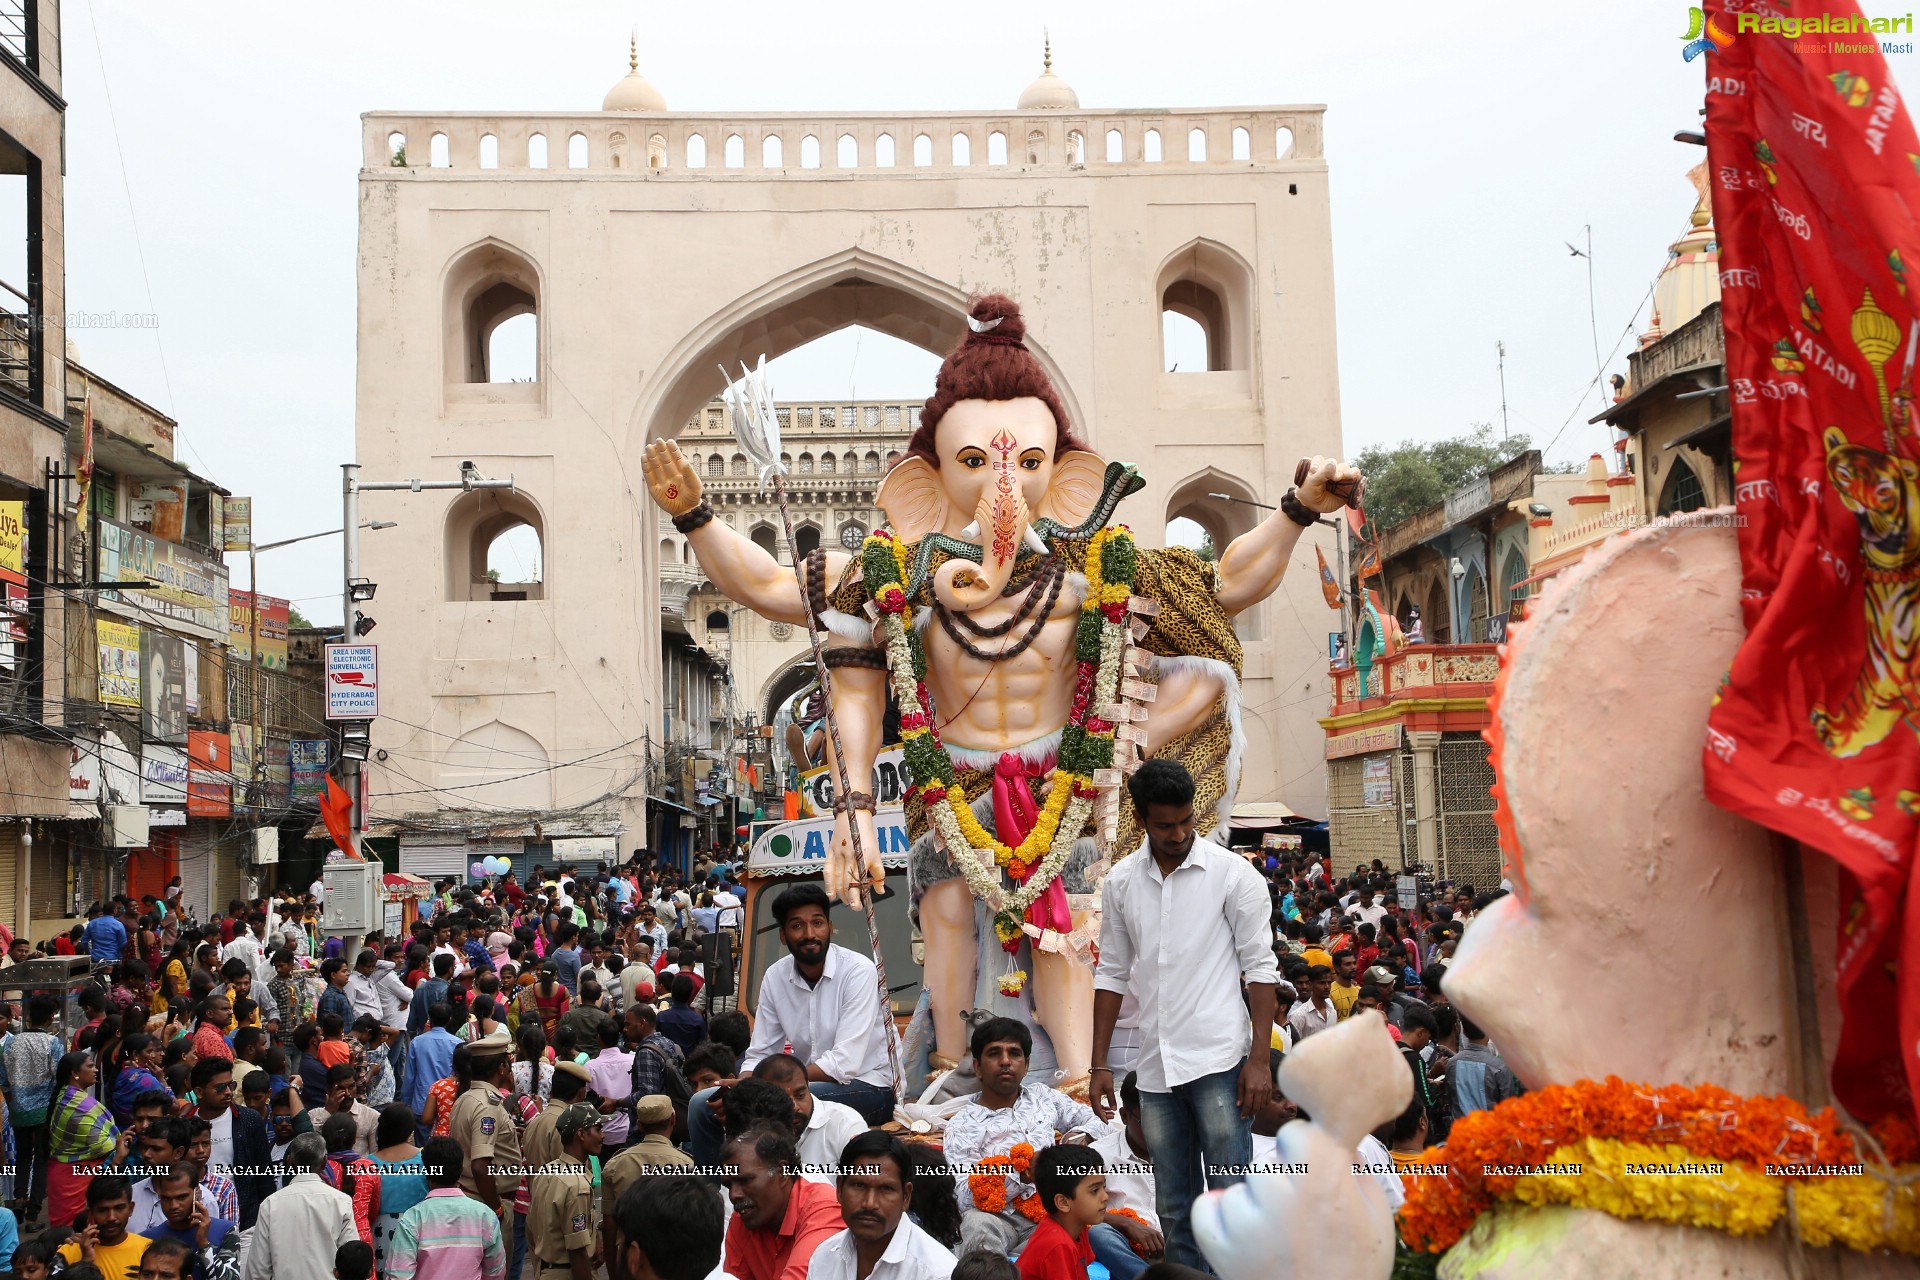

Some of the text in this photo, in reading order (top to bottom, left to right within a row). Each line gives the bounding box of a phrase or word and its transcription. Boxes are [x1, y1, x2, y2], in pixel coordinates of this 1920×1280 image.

[332, 648, 372, 656] AREA UNDER
[333, 655, 372, 663] ELECTRONIC
[329, 663, 375, 671] SURVEILLANCE
[331, 691, 375, 699] HYDERABAD
[349, 699, 376, 707] POLICE
